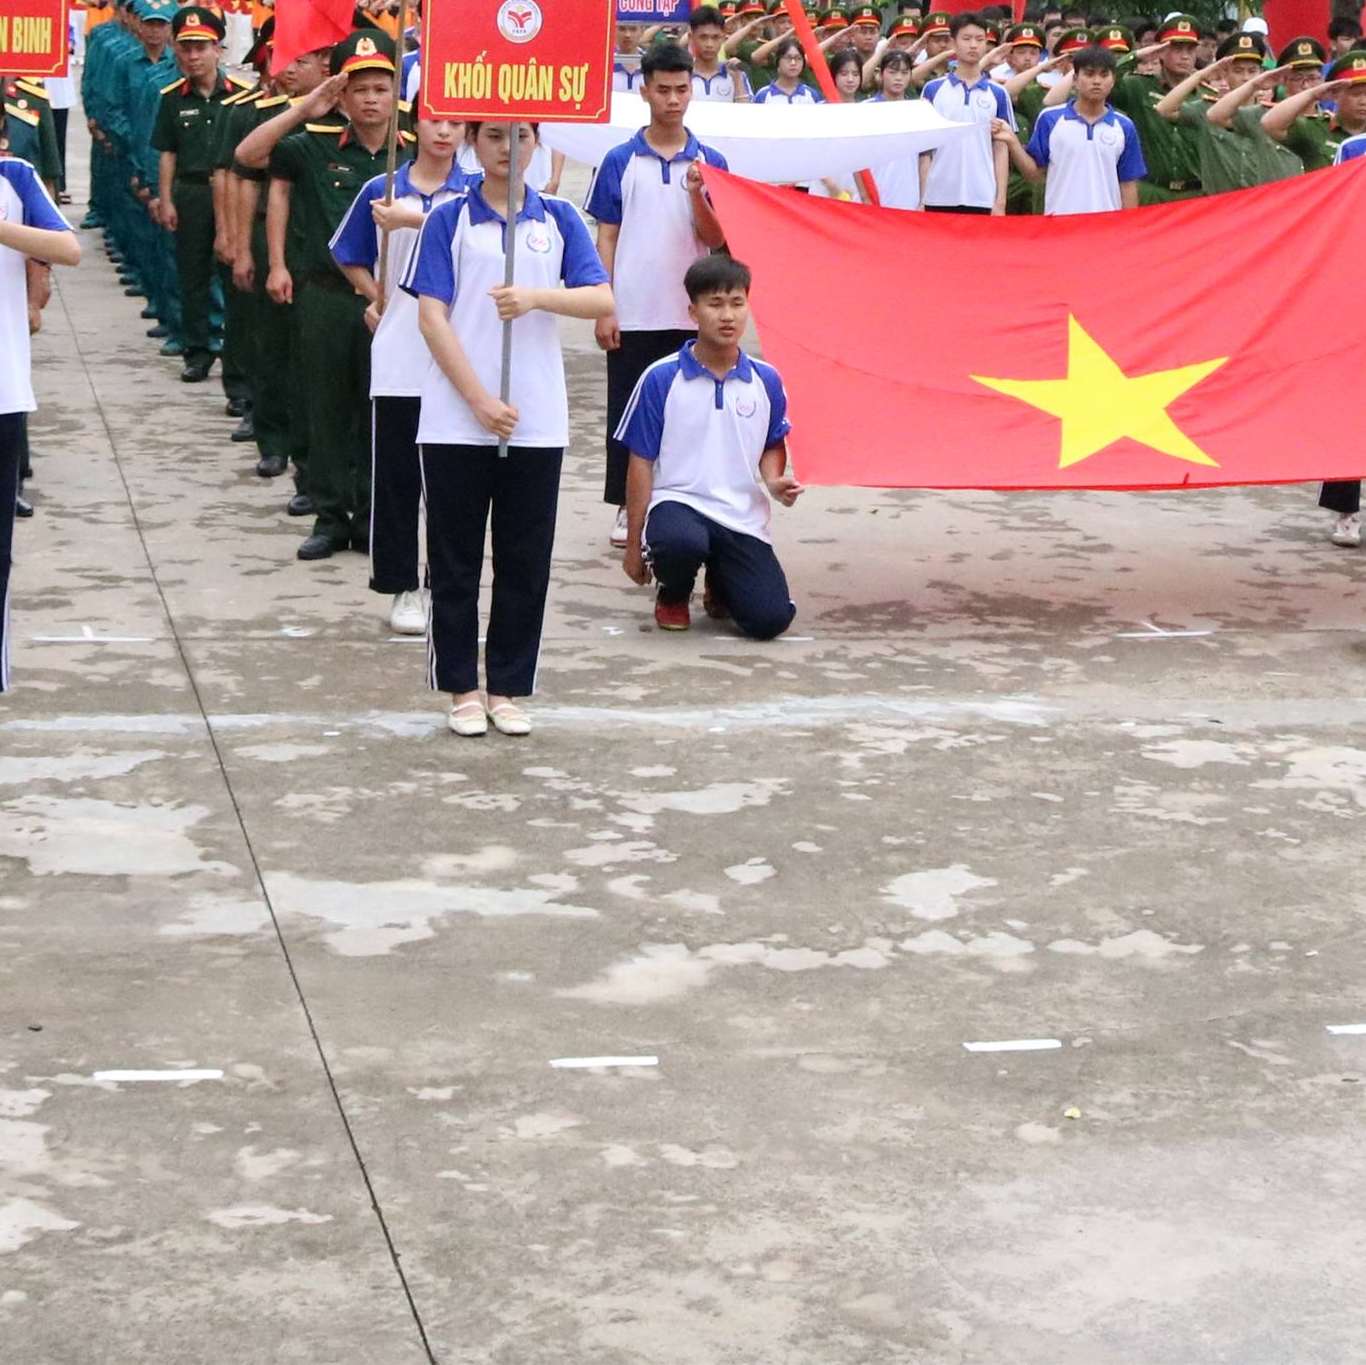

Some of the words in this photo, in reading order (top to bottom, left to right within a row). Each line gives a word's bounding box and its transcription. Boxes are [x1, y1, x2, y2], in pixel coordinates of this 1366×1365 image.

[12, 17, 52, 54] BINH
[444, 51, 492, 100] KHỐI
[498, 58, 554, 104] QUÂN
[559, 63, 589, 110] SỰ
